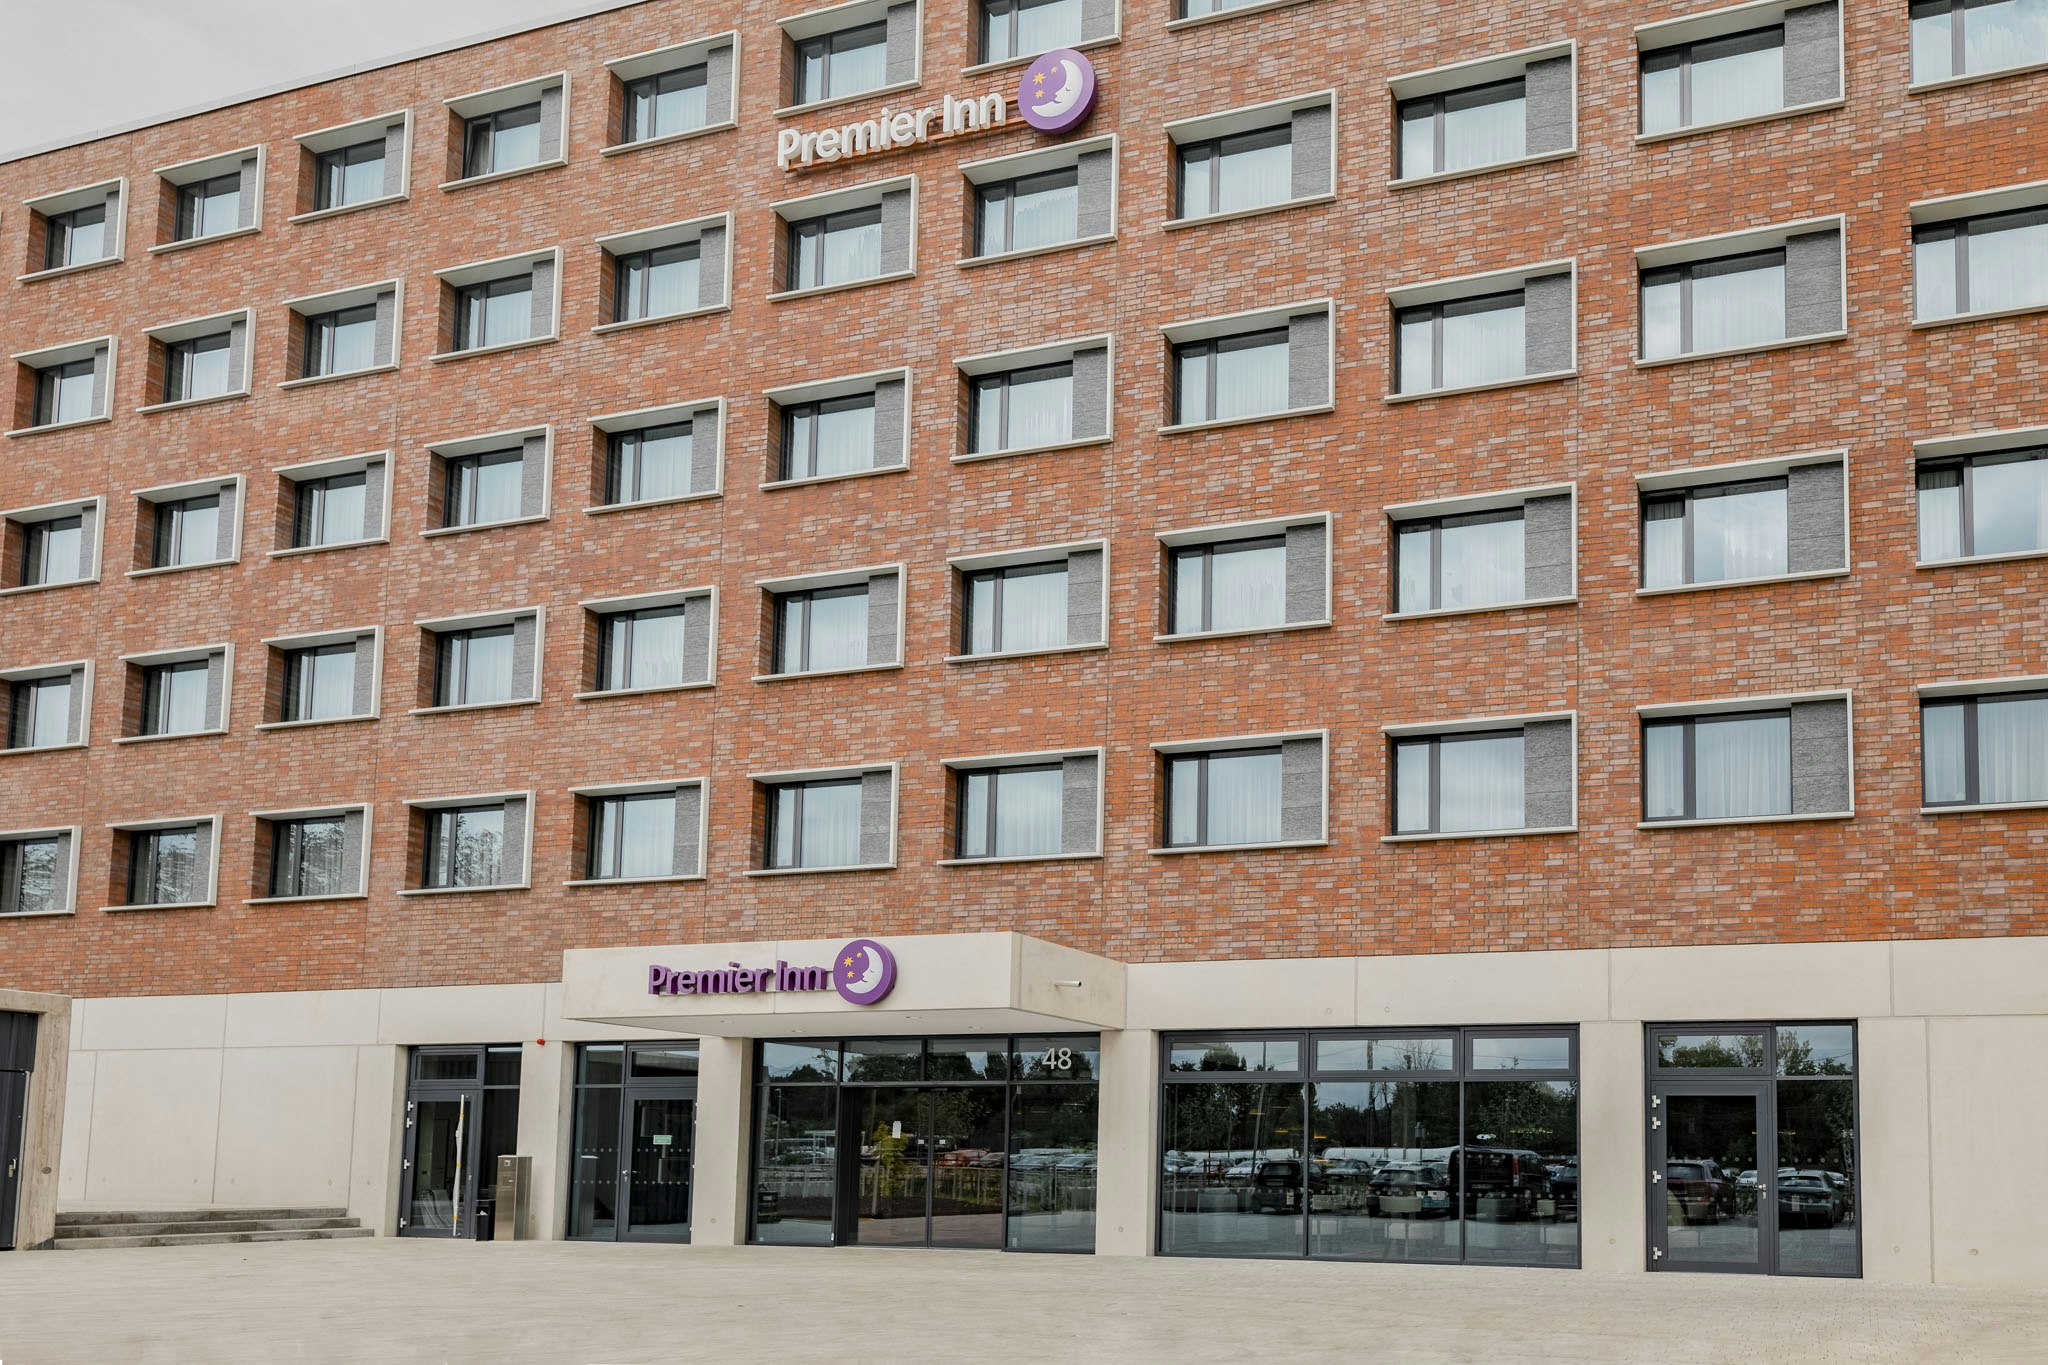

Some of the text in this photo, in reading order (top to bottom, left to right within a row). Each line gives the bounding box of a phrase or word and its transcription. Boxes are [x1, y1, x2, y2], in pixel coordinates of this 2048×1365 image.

[777, 93, 1006, 171] Premier Inn
[648, 960, 827, 995] Premier Inn
[1041, 1047, 1072, 1070] 48
